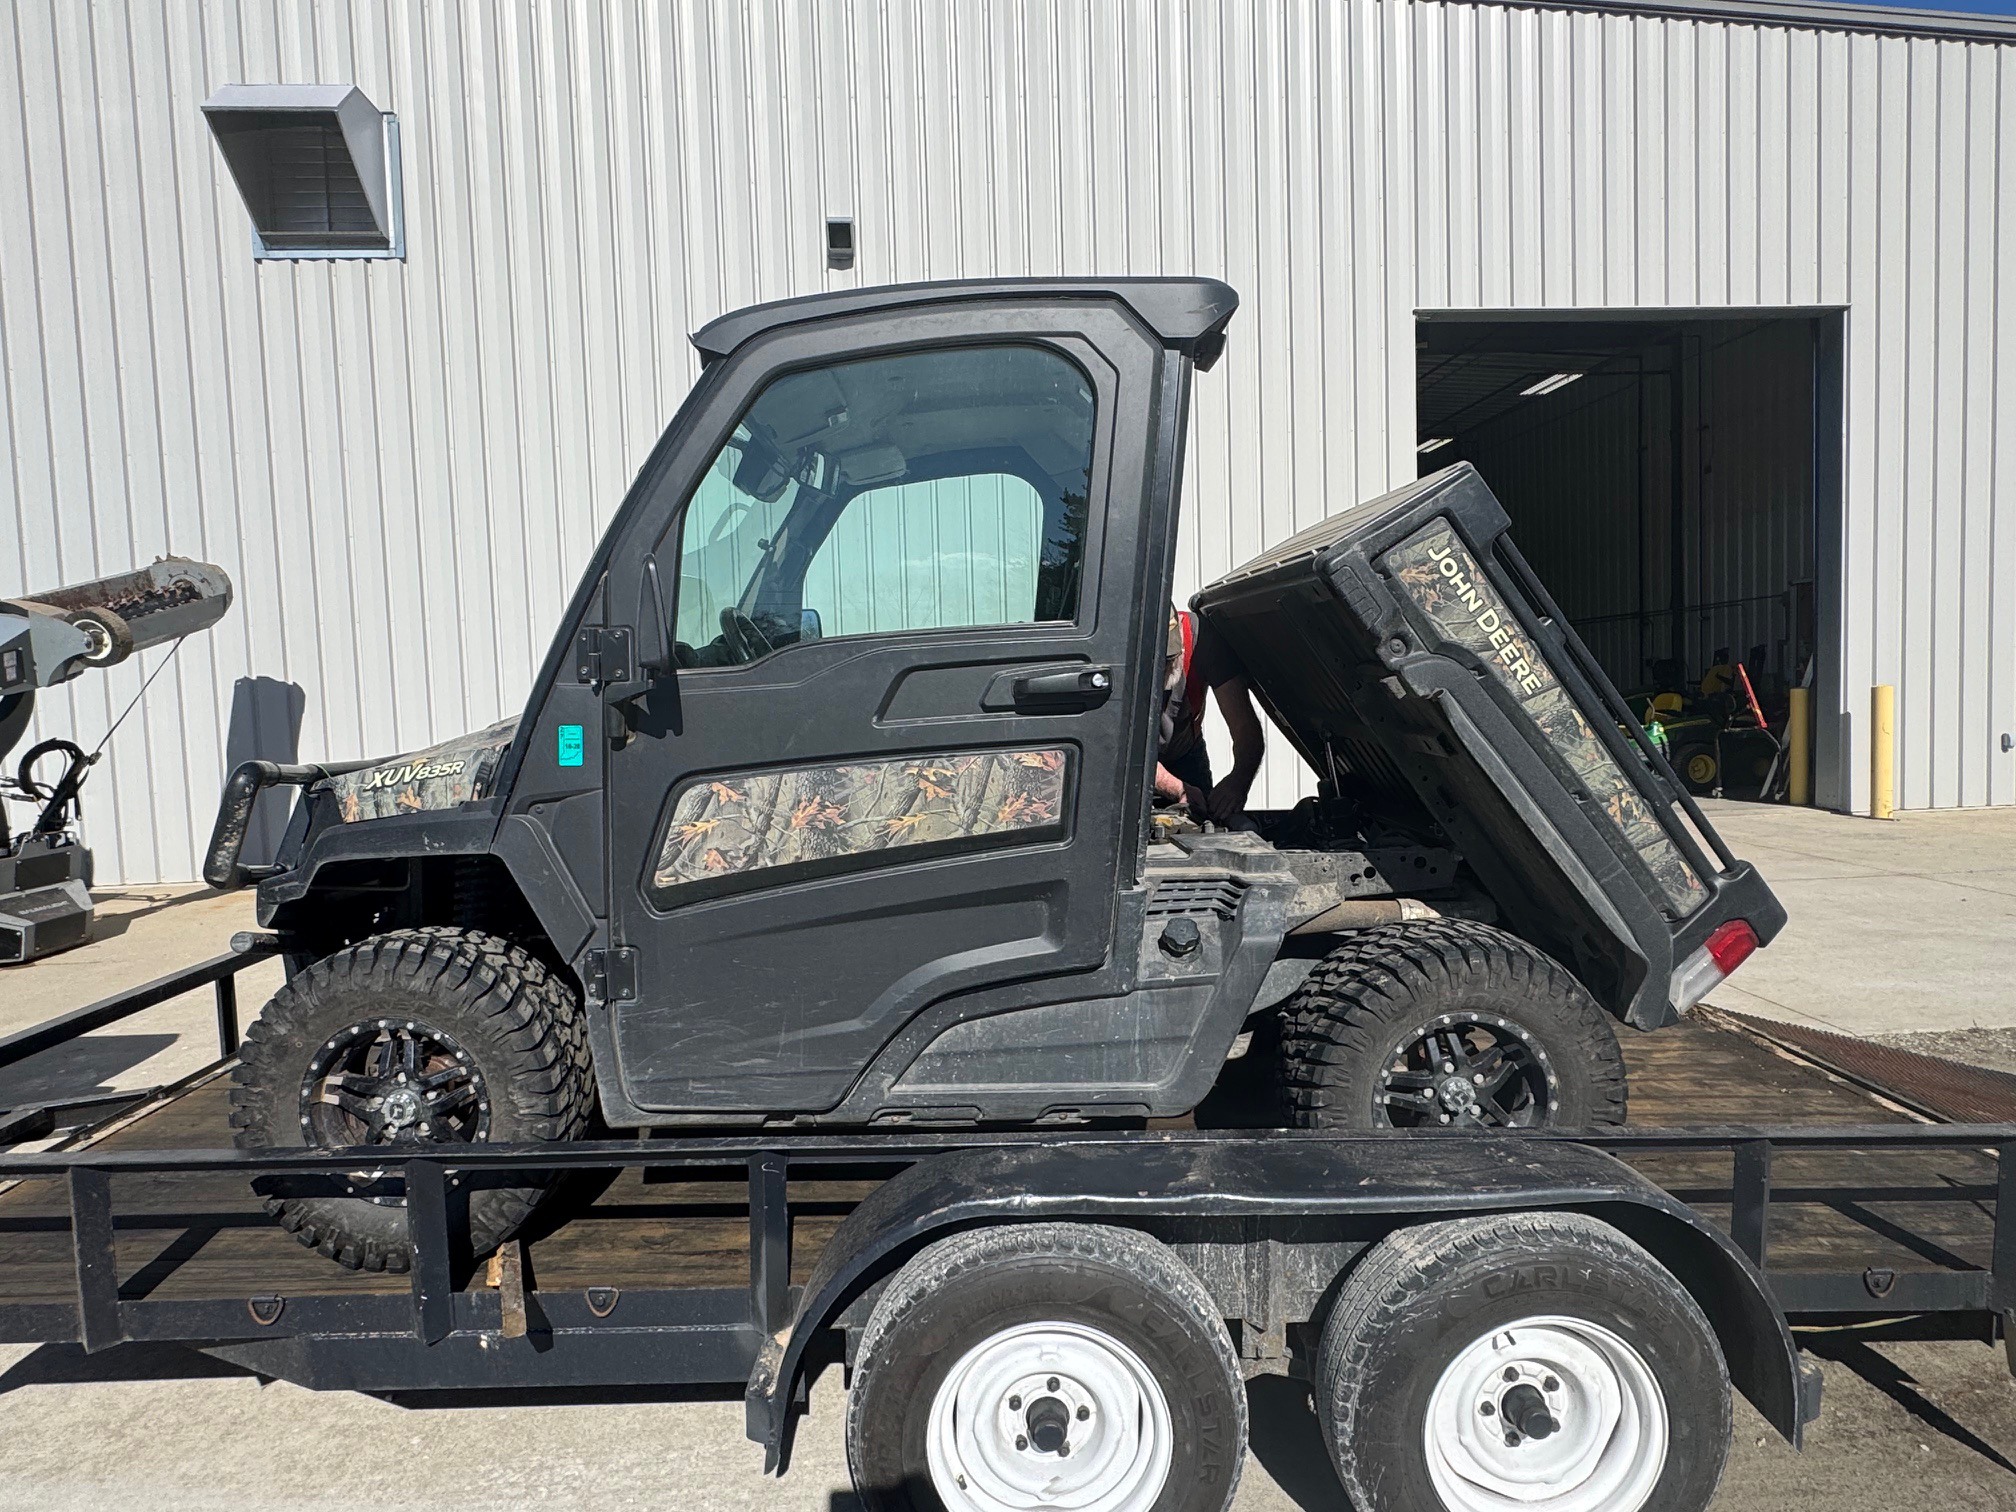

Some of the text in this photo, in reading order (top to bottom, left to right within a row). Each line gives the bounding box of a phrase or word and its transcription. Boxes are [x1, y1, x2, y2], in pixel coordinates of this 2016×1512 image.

[1427, 545, 1543, 696] JOHN DEERE
[364, 760, 466, 791] XUV835R
